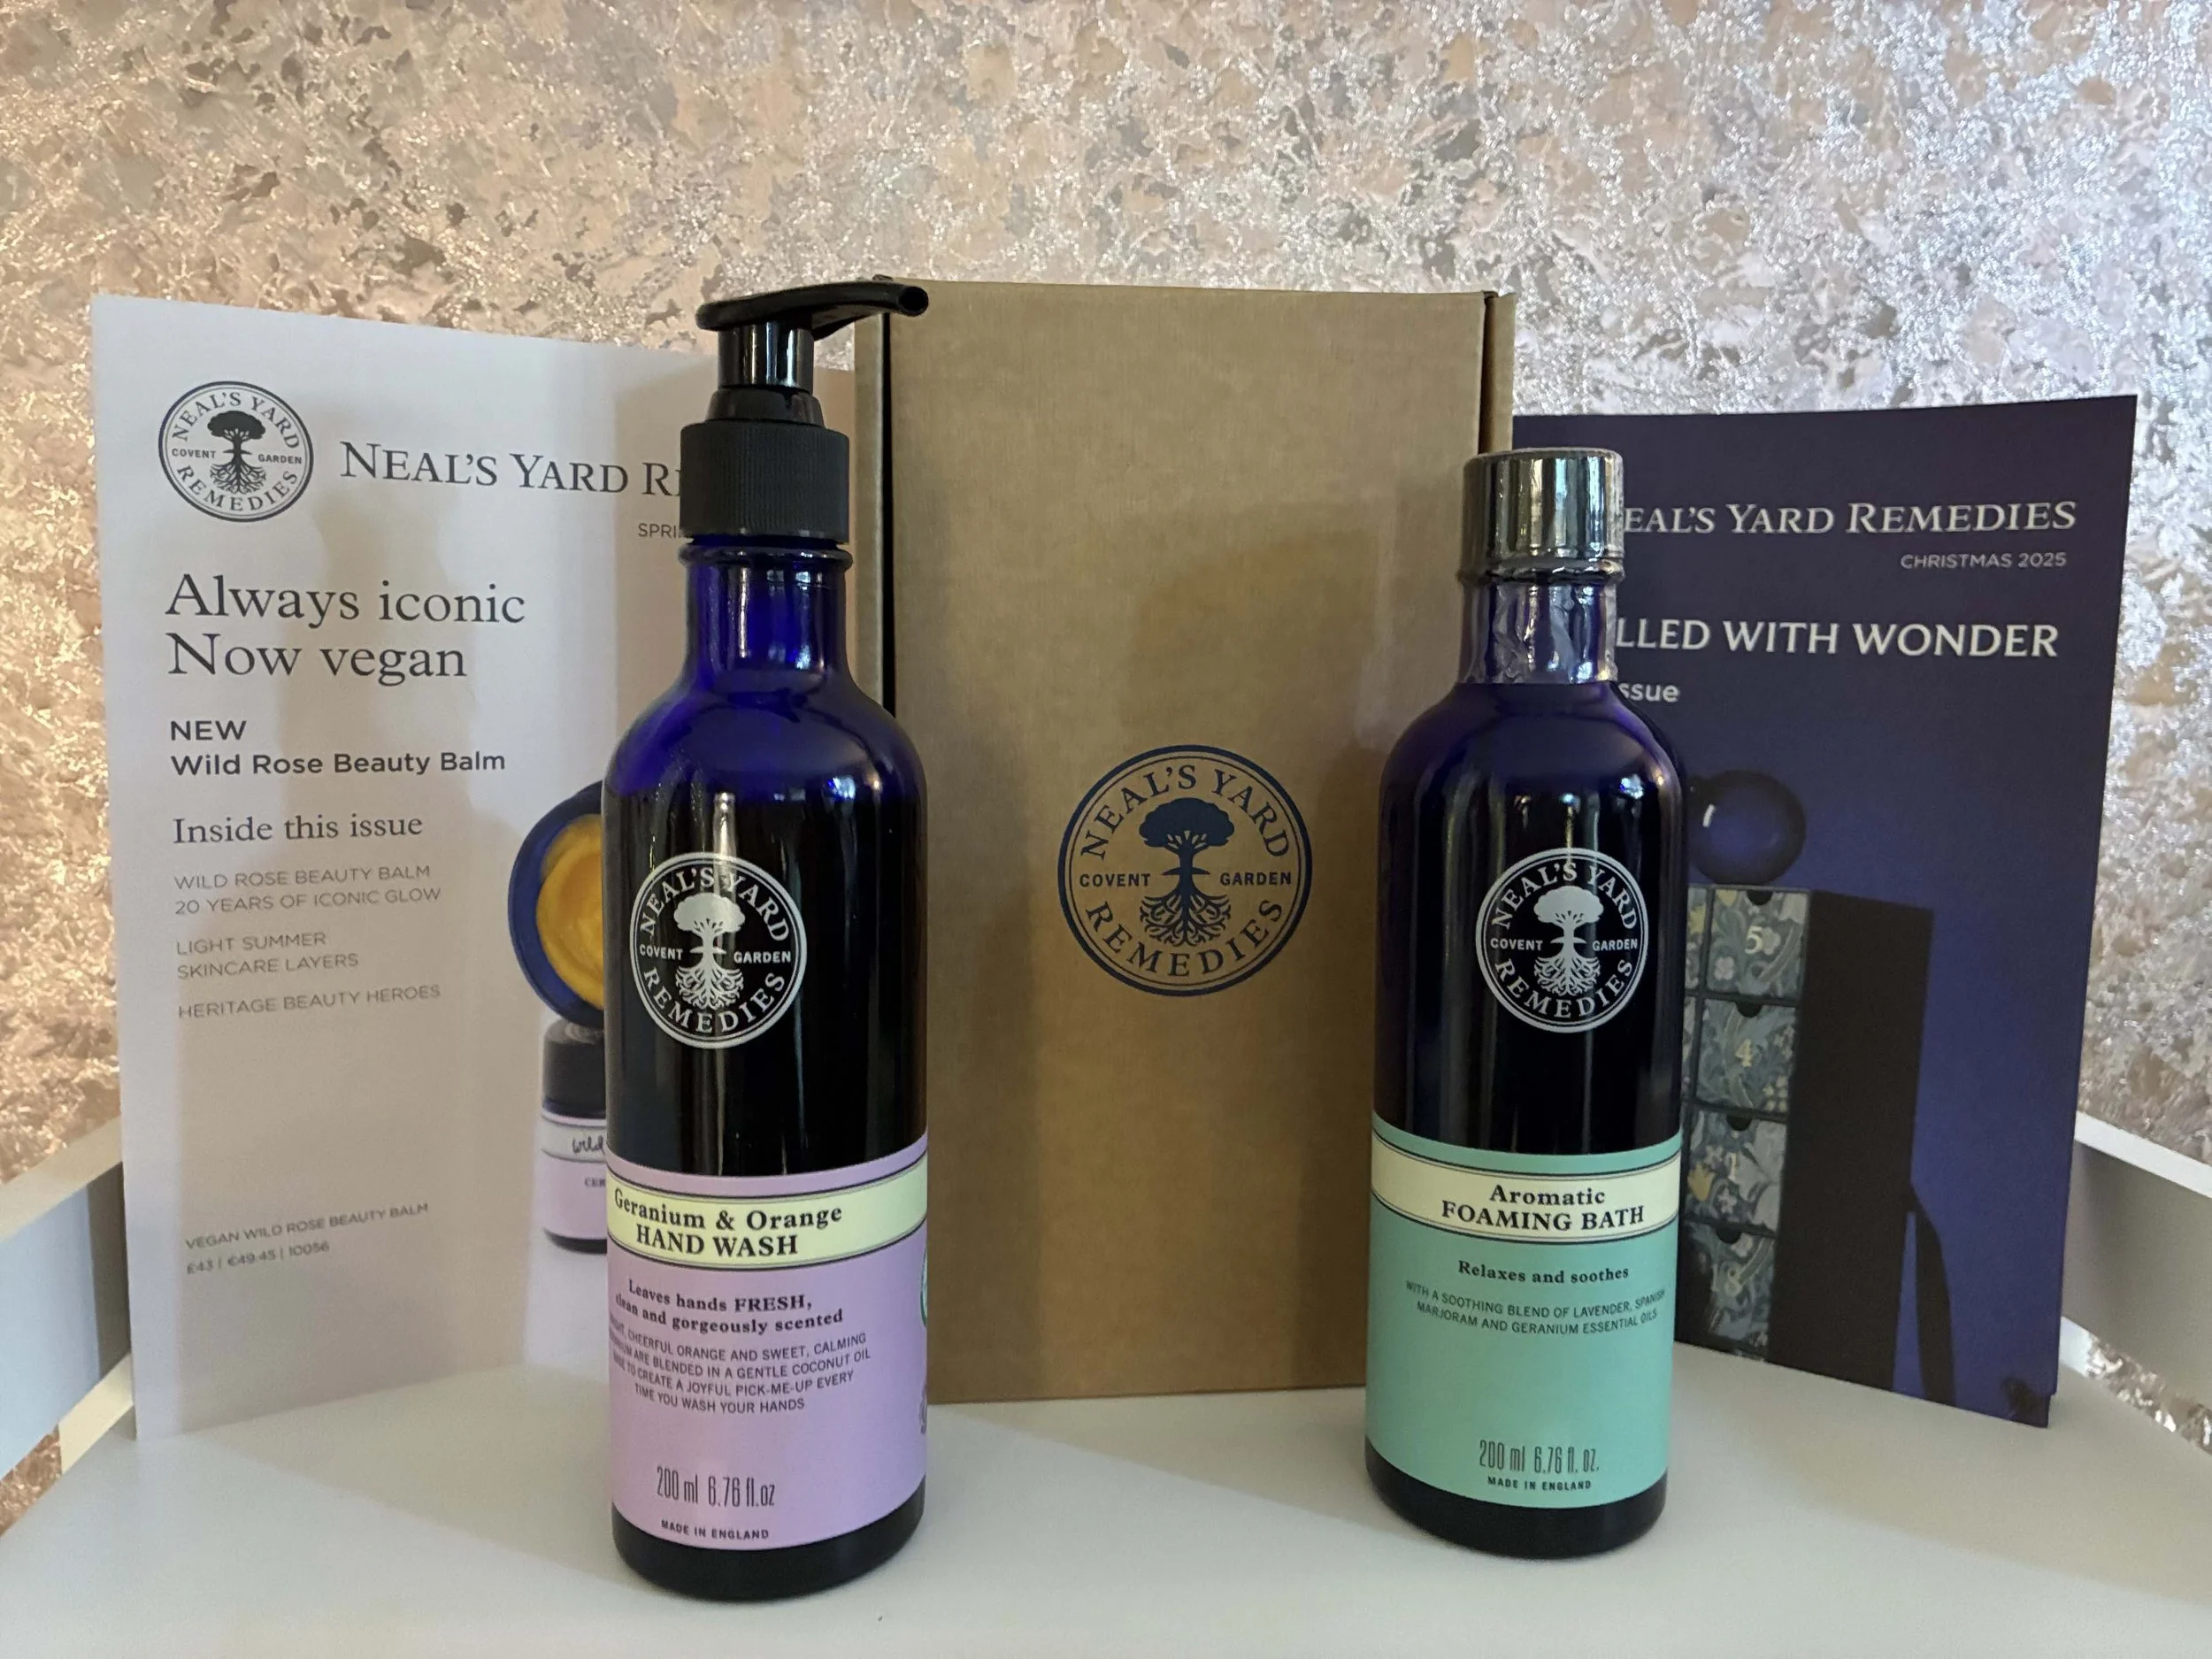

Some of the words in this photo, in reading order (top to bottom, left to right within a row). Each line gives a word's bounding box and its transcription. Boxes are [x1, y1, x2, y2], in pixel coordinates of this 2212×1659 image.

[173, 392, 242, 442] NEAL'S
[251, 396, 300, 449] YARD
[172, 448, 216, 459] COVENT
[257, 453, 303, 465] GARDEN
[340, 441, 498, 487] NEAL'S
[509, 452, 628, 493] YARD
[641, 462, 680, 496] R
[177, 465, 298, 511] REMEDIES
[637, 522, 680, 539] SPRI
[1624, 506, 1717, 534] EAL'S
[1726, 503, 1835, 534] YARD
[1846, 501, 2077, 534] REMEDIES
[1900, 552, 2012, 570] CHRISTMAS
[2018, 551, 2067, 568] 2025
[165, 572, 360, 630] Always
[378, 580, 525, 624] iconic
[1616, 617, 1711, 650] LLED
[1722, 621, 1839, 655] WITH
[1852, 623, 2060, 657] WONDER
[165, 632, 303, 676] Now
[319, 647, 468, 687] vegan
[1617, 681, 1679, 703] ssue
[170, 719, 247, 741] NEW
[170, 754, 242, 775] Wild
[252, 755, 324, 774] Rose
[334, 752, 431, 775] Beauty
[441, 750, 506, 772] Balm
[173, 816, 273, 844] Inside
[284, 813, 339, 840] this
[349, 812, 423, 837] issue
[1080, 764, 1196, 861] NEAL'S
[1211, 768, 1290, 857] YARD
[173, 873, 228, 890] WILD
[234, 871, 289, 887] ROSE
[295, 866, 373, 884] BEAUTY
[378, 864, 431, 880] BALM
[1079, 872, 1151, 887] COVENT
[1220, 871, 1292, 887] GARDEN
[174, 898, 201, 916] 20
[206, 895, 274, 913] YEARS
[279, 893, 308, 910] OF
[313, 890, 380, 908] ICONIC
[384, 887, 442, 904] GLOW
[640, 866, 716, 936] NEAL'S
[729, 872, 790, 941] YARD
[1491, 861, 1578, 930] NEAL'S
[1587, 864, 1638, 930] YARD
[176, 936, 235, 956] LIGHT
[242, 931, 327, 952] SUMMER
[639, 942, 684, 961] COVENT
[733, 950, 792, 964] GARDEN
[1084, 898, 1283, 977] REMEDIES
[1490, 938, 1544, 951] COVENT
[1592, 938, 1639, 952] GARDEN
[1744, 926, 1763, 955] 5
[177, 957, 280, 980] SKINCARE
[285, 952, 359, 972] LAYERS
[178, 996, 278, 1019] HERITAGE
[283, 990, 361, 1010] BEAUTY
[365, 983, 441, 1003] HEROES
[643, 966, 786, 1034] REMEDIES
[1494, 957, 1633, 1018] REMEDIES
[614, 1187, 706, 1230] Geranium
[715, 1211, 734, 1232] &
[746, 1203, 843, 1232] Orange
[1489, 1183, 1606, 1206] Aromatic
[185, 1231, 241, 1249] VEGAN
[243, 1224, 283, 1240] WILD
[286, 1217, 326, 1233] ROSE
[329, 1209, 387, 1228] BEAUTY
[389, 1202, 429, 1218] BALM
[1440, 1199, 1572, 1232] FOAMING
[1581, 1205, 1645, 1231] BATH
[635, 1223, 705, 1256] HAND
[712, 1233, 799, 1258] WASH
[1457, 1260, 1526, 1283] Relaxes
[1532, 1271, 1564, 1284] and
[1571, 1267, 1630, 1284] soothes
[628, 1278, 671, 1306] Leaves
[676, 1294, 727, 1312] hands
[734, 1294, 812, 1314] FRESH,
[1405, 1279, 1430, 1298] WITH
[1432, 1290, 1440, 1302] A
[1441, 1292, 1503, 1315] SOOTHING
[1507, 1305, 1550, 1318] BLEND
[1553, 1305, 1570, 1318] OF
[1573, 1301, 1632, 1318] LAVENDER,
[1633, 1288, 1666, 1310] SPANISH
[642, 1308, 667, 1325] and
[672, 1316, 768, 1336] gorgeously
[774, 1308, 844, 1331] scented
[1416, 1300, 1479, 1326] MARJORAM
[1481, 1318, 1509, 1332] AND
[1511, 1322, 1580, 1335] GERANIUM
[1582, 1317, 1639, 1334] ESSENTIAL
[1640, 1307, 1658, 1325] OILS
[626, 1328, 673, 1356] CHEERFUL
[677, 1344, 726, 1362] ORANGE
[731, 1348, 758, 1363] AND
[762, 1345, 810, 1362] SWEET,
[813, 1332, 867, 1356] CALMING
[626, 1362, 637, 1378] TO
[637, 1367, 673, 1390] CREATE
[676, 1379, 684, 1392] A
[687, 1381, 732, 1397] JOYFUL
[735, 1378, 813, 1397] PICK-ME-UP
[817, 1369, 855, 1390] EVERY
[634, 1348, 650, 1366] ARE
[653, 1355, 704, 1378] BLENDED
[708, 1367, 721, 1379] IN
[725, 1366, 733, 1379] A
[737, 1364, 788, 1380] GENTLE
[792, 1354, 850, 1377] COCONUT
[853, 1348, 872, 1363] OIL
[634, 1382, 656, 1402] TIME
[657, 1392, 679, 1407] YOU
[681, 1396, 717, 1413] WASH
[719, 1400, 756, 1414] YOUR
[759, 1397, 806, 1414] HANDS
[1479, 1439, 1506, 1471] 200
[1509, 1445, 1525, 1472] ml
[1534, 1446, 1563, 1474] 6.76
[657, 1465, 680, 1502] 200
[684, 1473, 699, 1505] ml
[708, 1476, 741, 1508] 6.76
[1487, 1475, 1519, 1489] MADE
[1525, 1480, 1537, 1491] IN
[1541, 1480, 1593, 1492] ENGLAND
[661, 1519, 690, 1536] MADE
[694, 1527, 708, 1540] IN
[711, 1528, 770, 1541] ENGLAND
